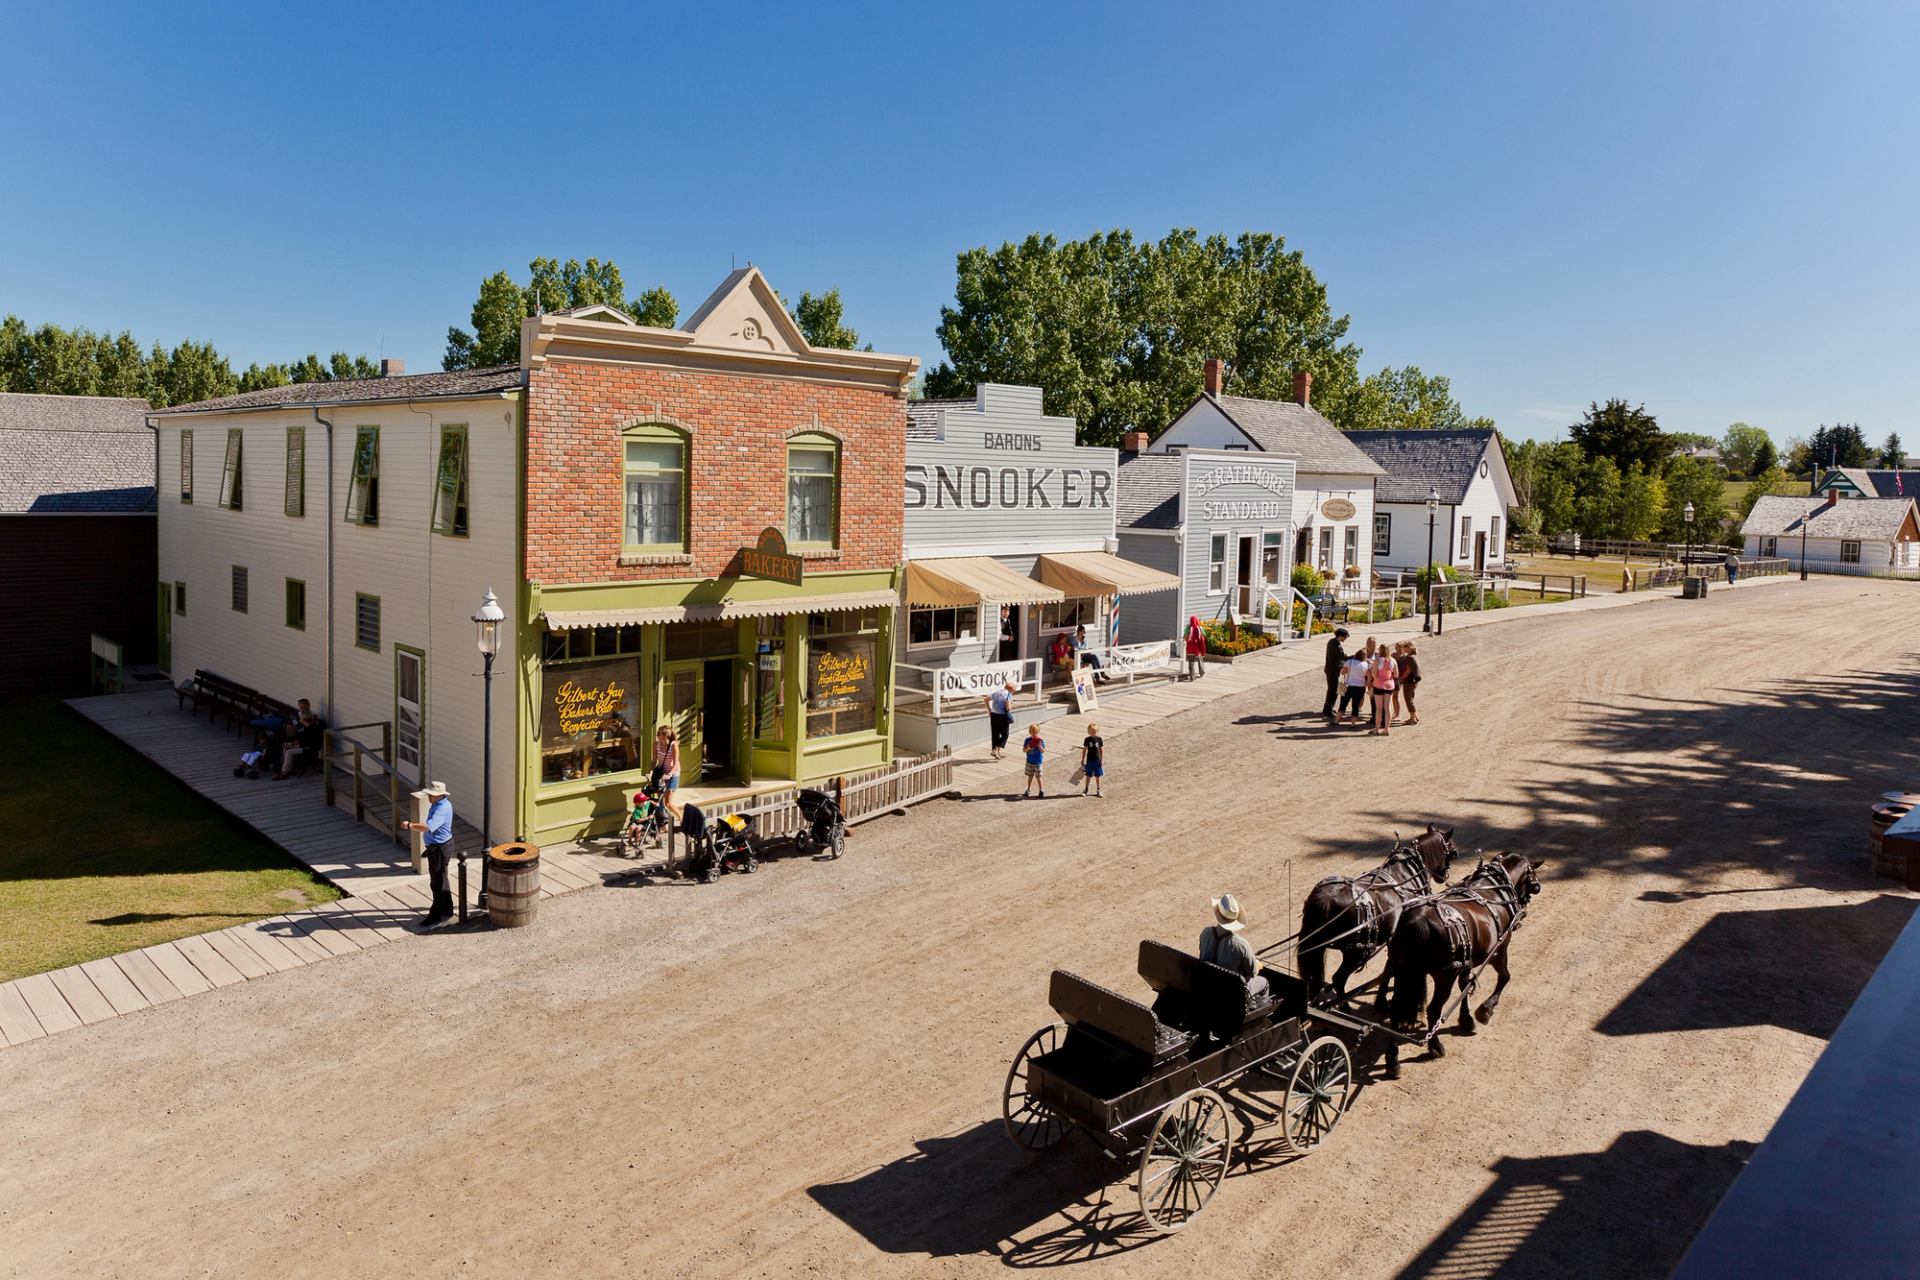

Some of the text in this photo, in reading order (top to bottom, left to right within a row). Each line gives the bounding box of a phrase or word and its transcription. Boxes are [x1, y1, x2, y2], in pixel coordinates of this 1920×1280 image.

[984, 432, 1042, 452] BARONS
[904, 465, 1112, 509] SNOOKER
[1194, 465, 1288, 498] STRATHMORE
[1203, 501, 1279, 521] STANDARD
[745, 552, 799, 580] BAKERY
[946, 676, 966, 691] OIL
[971, 671, 1009, 689] STOCK
[556, 682, 599, 704] Gilbert
[605, 682, 624, 704] Jay
[560, 719, 618, 735] Confectio
